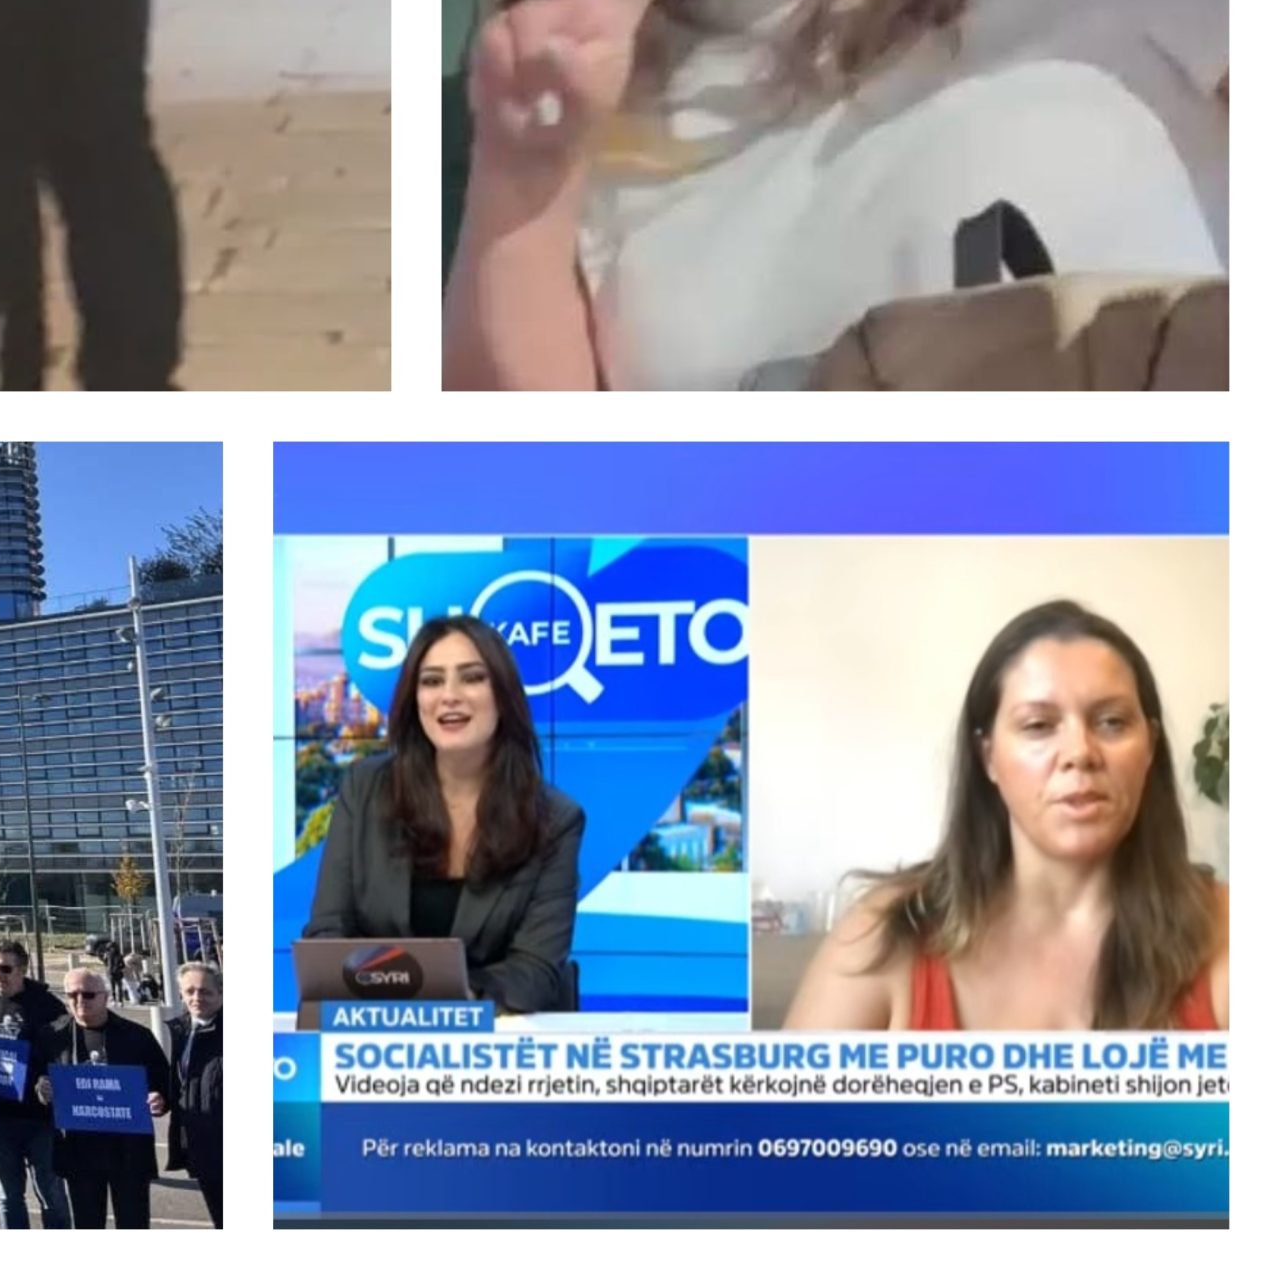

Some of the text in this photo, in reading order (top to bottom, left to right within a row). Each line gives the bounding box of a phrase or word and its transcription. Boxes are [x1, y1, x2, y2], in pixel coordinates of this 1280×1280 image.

[75, 1077, 121, 1091] EDI RAMA
[71, 1104, 132, 1119] NARCOSTATE
